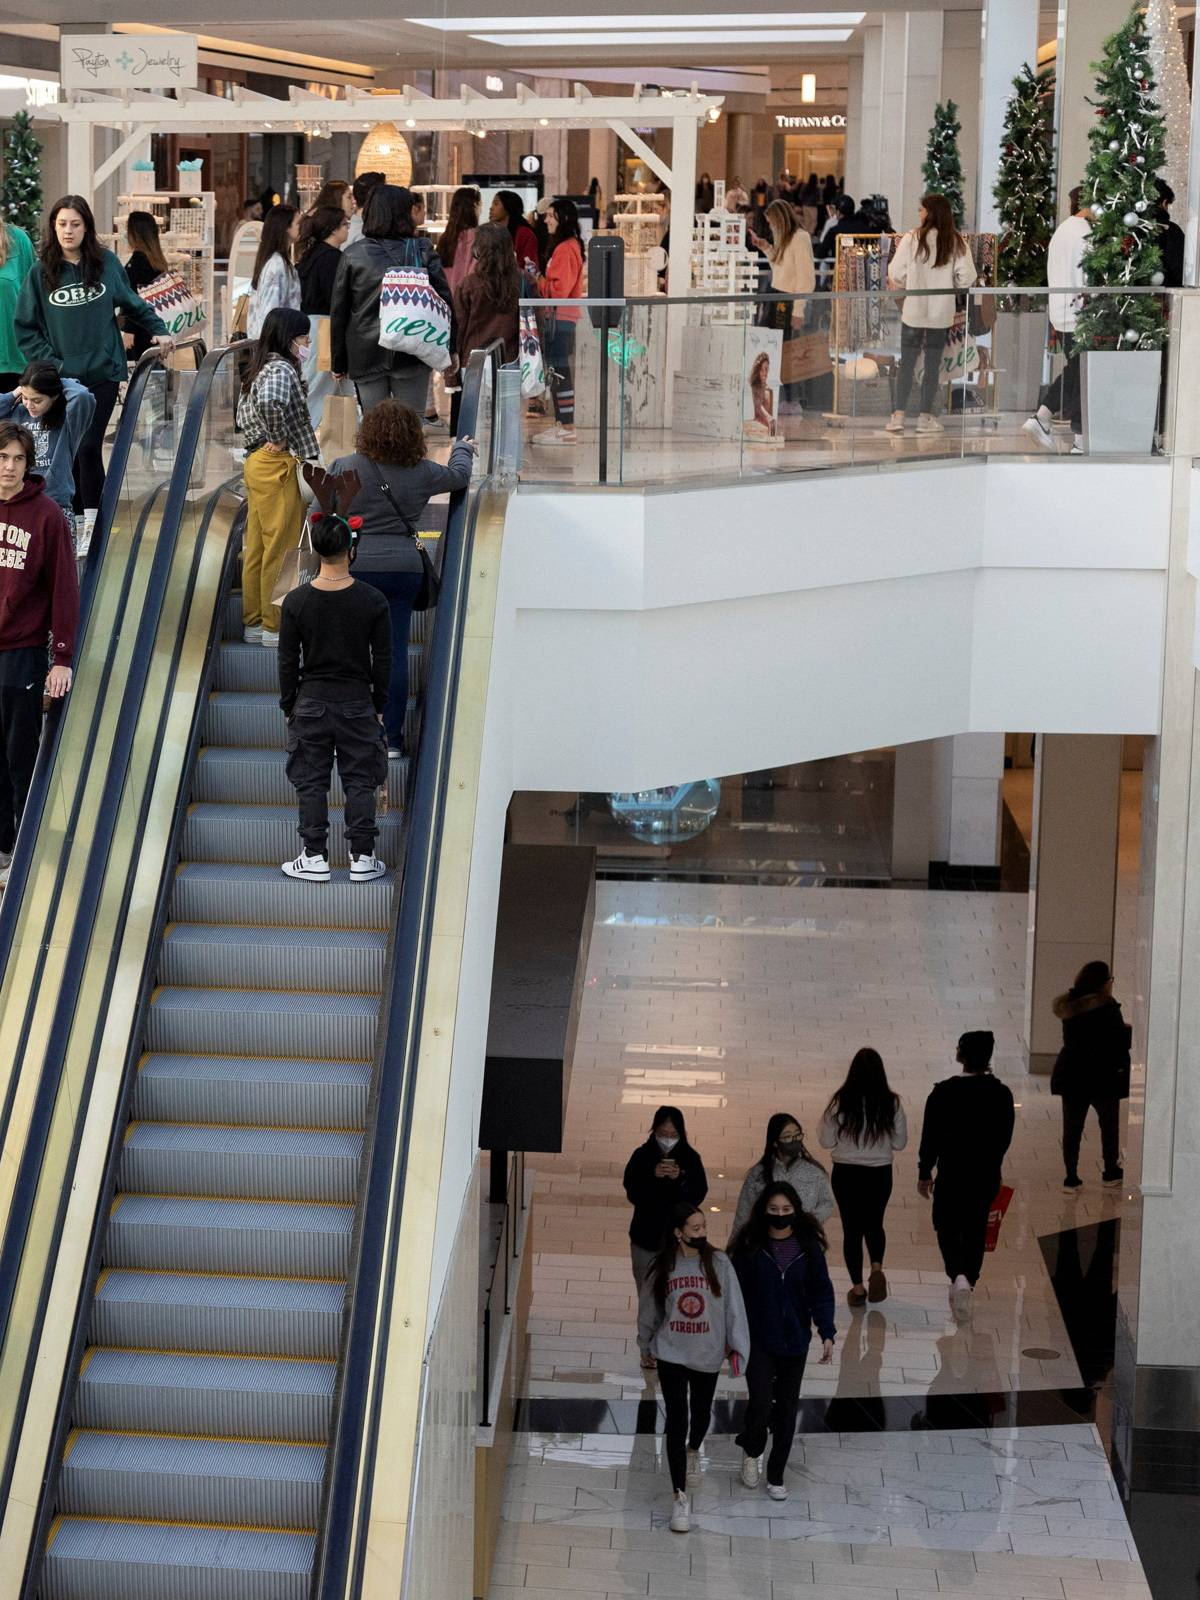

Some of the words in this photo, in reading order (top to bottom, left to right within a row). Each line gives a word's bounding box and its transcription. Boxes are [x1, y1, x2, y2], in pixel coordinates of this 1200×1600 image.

[72, 47, 111, 77] Payton
[131, 47, 187, 77] Jewelry
[670, 1320, 710, 1334] VIRGINIA
